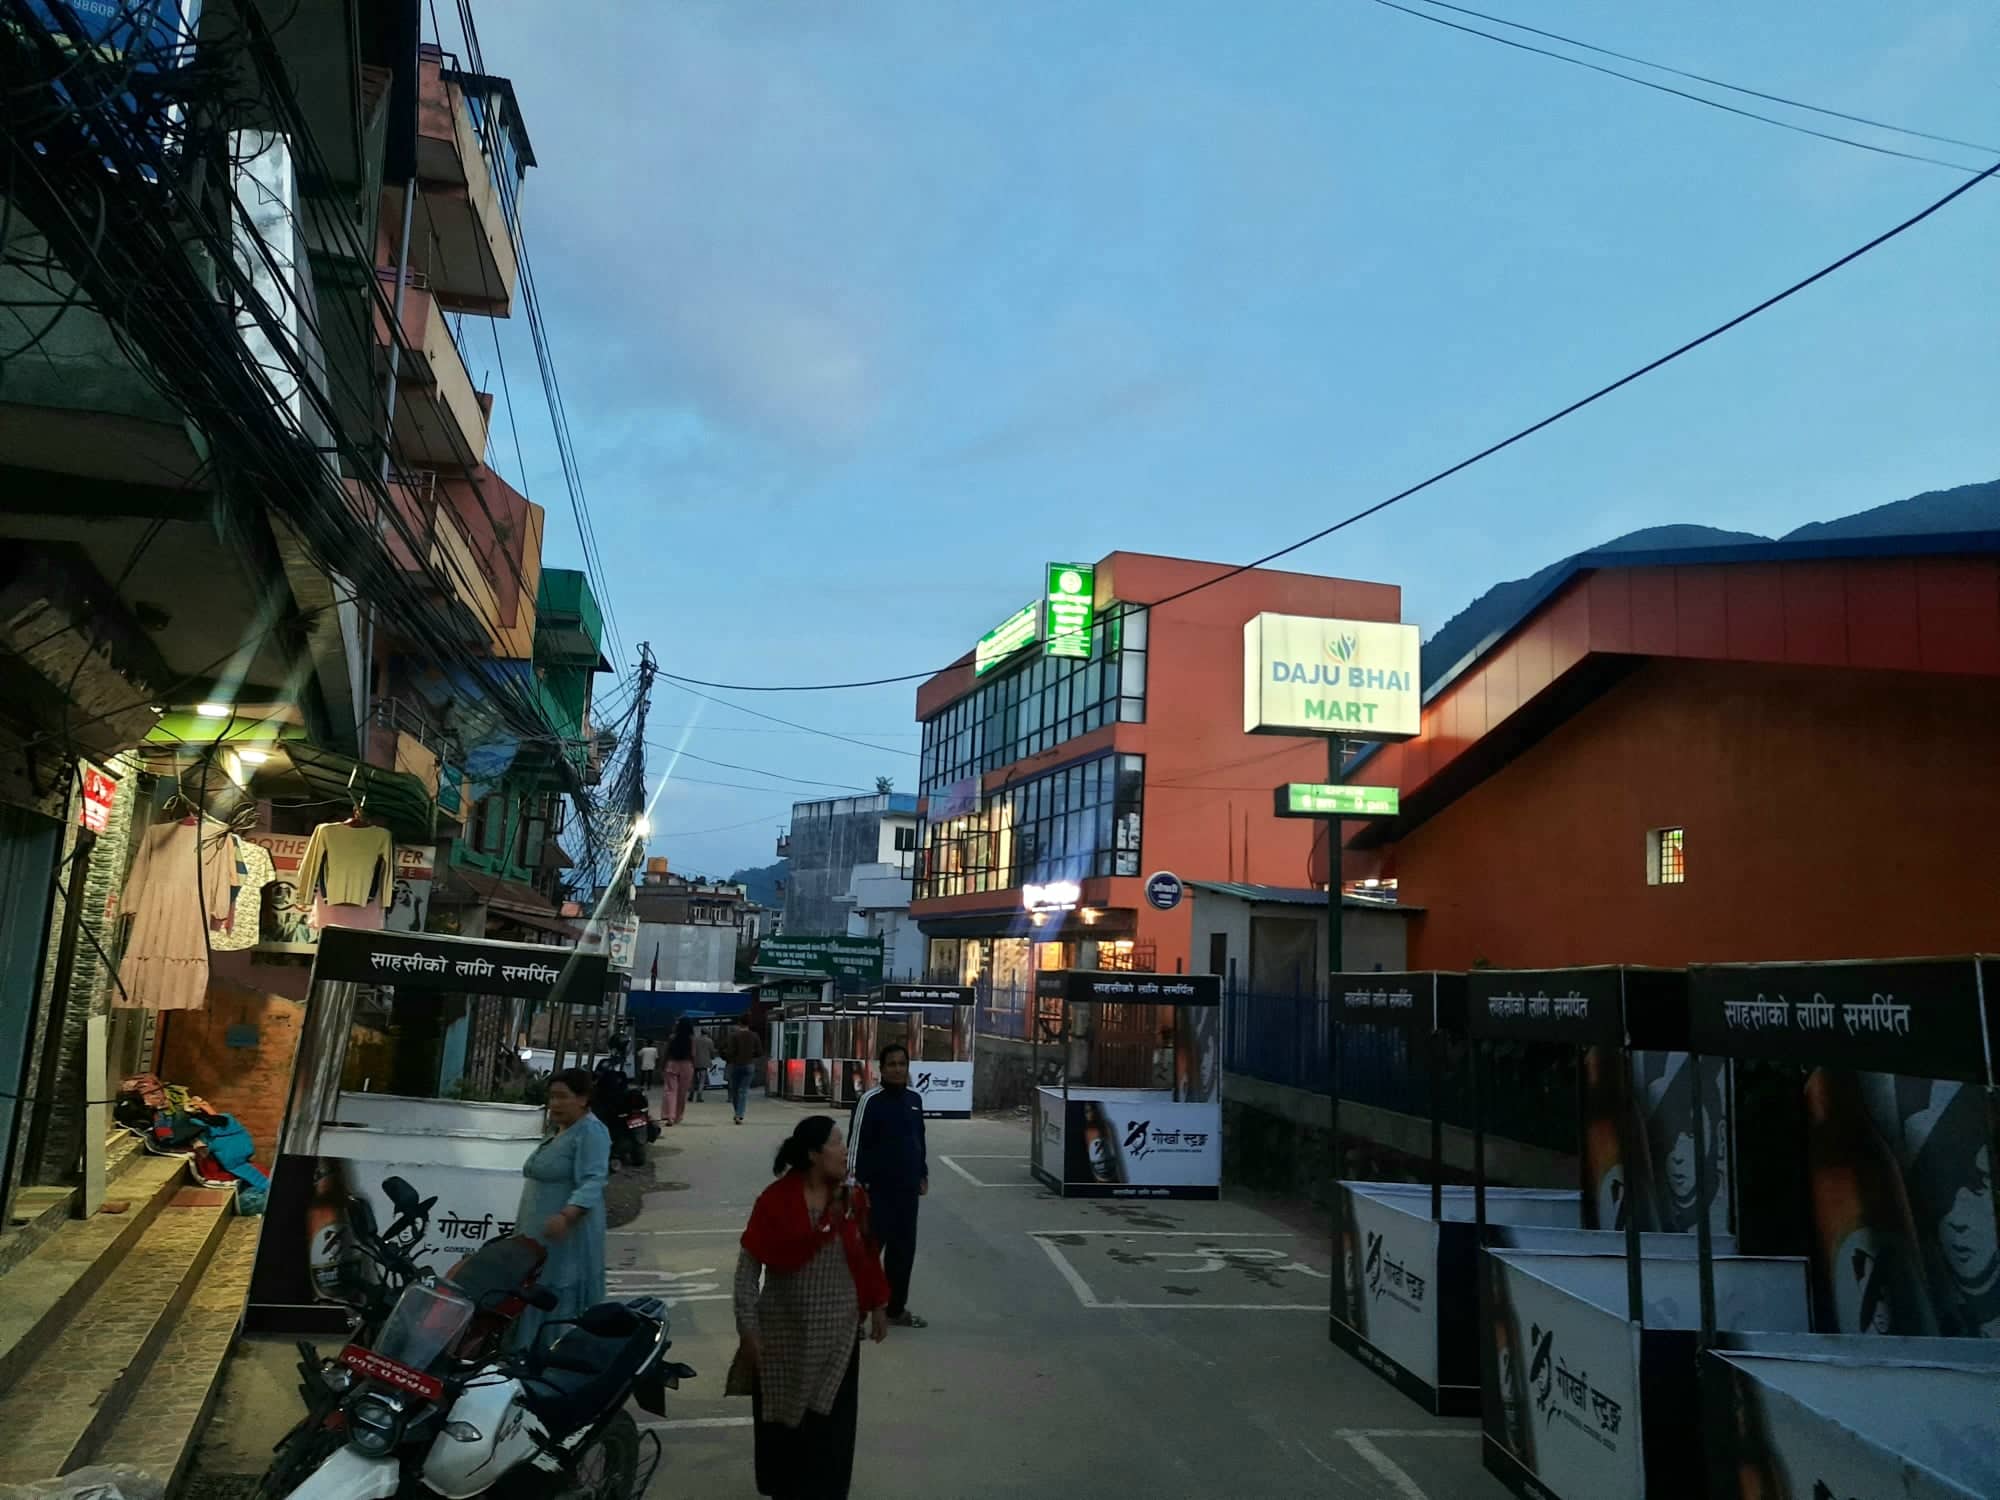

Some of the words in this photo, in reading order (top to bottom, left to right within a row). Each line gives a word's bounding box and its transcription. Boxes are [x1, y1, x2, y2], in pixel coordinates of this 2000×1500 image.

[1272, 661, 1340, 686] DAJU
[1348, 668, 1410, 691] BHAI
[1304, 699, 1378, 723] MART
[370, 952, 449, 973] साहसीको
[455, 959, 496, 977] लागि
[502, 964, 560, 984] समर्पित
[1093, 981, 1133, 993] साहसीको
[1137, 982, 1159, 994] लागि
[1488, 991, 1525, 1016] साहसीको
[1528, 990, 1550, 1017] लागि
[1553, 990, 1590, 1019] समर्पित
[1723, 993, 1789, 1030] साहसीको
[1795, 992, 1836, 1031] लागि
[1842, 992, 1911, 1036] समर्पित
[1152, 1128, 1181, 1144] गोर्खा
[438, 1210, 493, 1240] गोर्खा
[1555, 1356, 1588, 1411] गोर्खा
